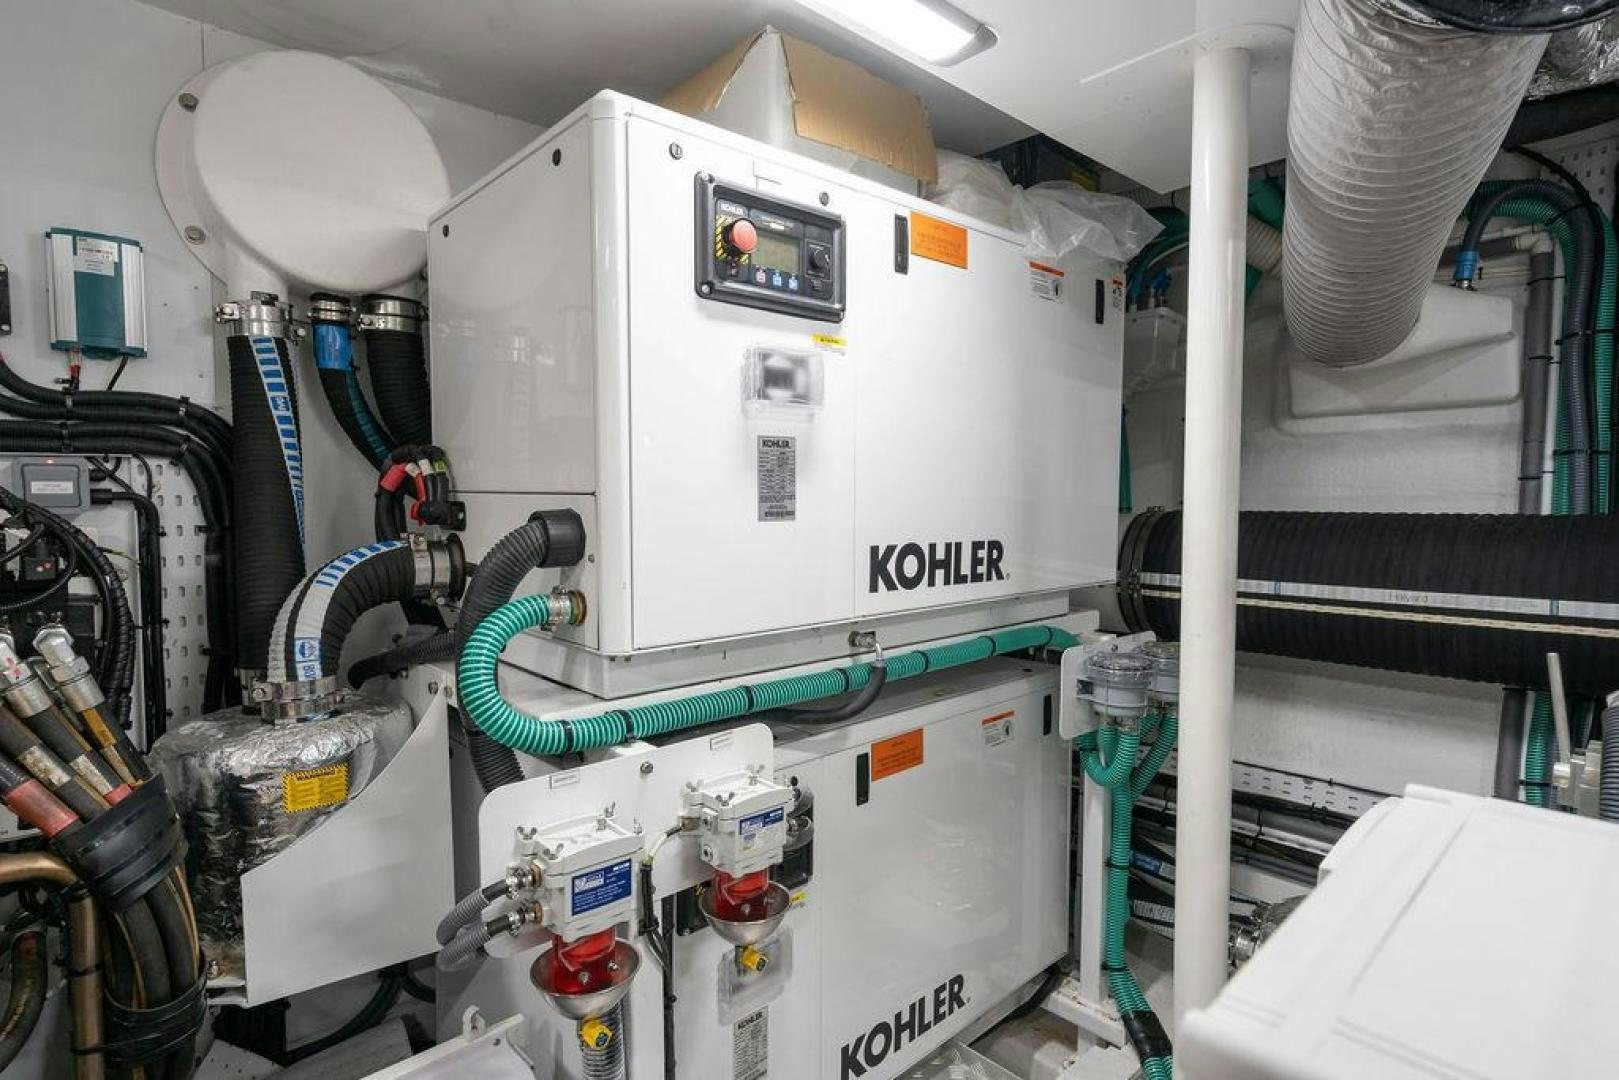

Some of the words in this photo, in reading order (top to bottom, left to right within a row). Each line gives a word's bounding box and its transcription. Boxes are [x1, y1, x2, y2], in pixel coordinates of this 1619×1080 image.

[762, 439, 790, 448] KOHLER
[868, 540, 1005, 593] KOHLER
[840, 973, 966, 1080] KOHLER
